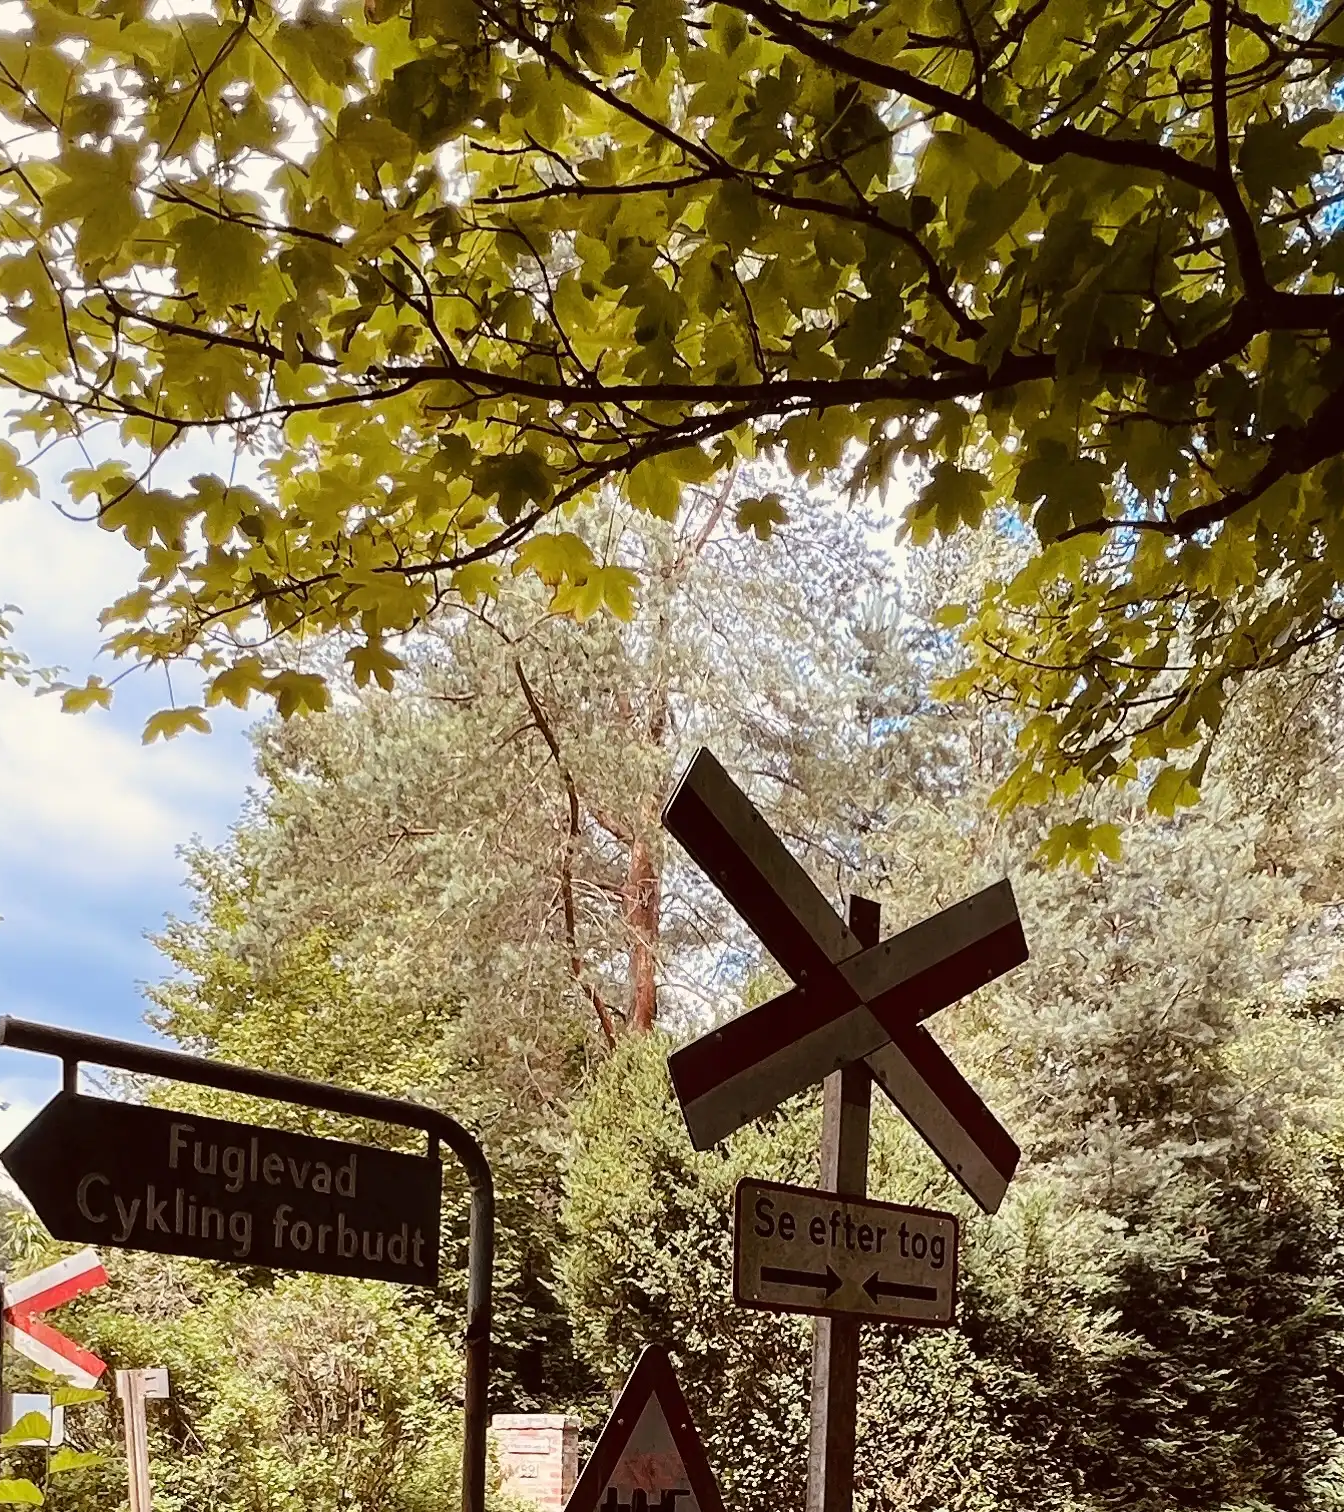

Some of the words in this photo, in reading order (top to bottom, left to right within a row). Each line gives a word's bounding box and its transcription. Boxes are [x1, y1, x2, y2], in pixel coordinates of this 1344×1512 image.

[169, 1122, 357, 1198] Fuglevad
[77, 1172, 253, 1257] Cykling
[272, 1204, 425, 1268] forbudt
[753, 1197, 796, 1241] Se
[808, 1209, 887, 1254] efter
[897, 1221, 946, 1269] tog
